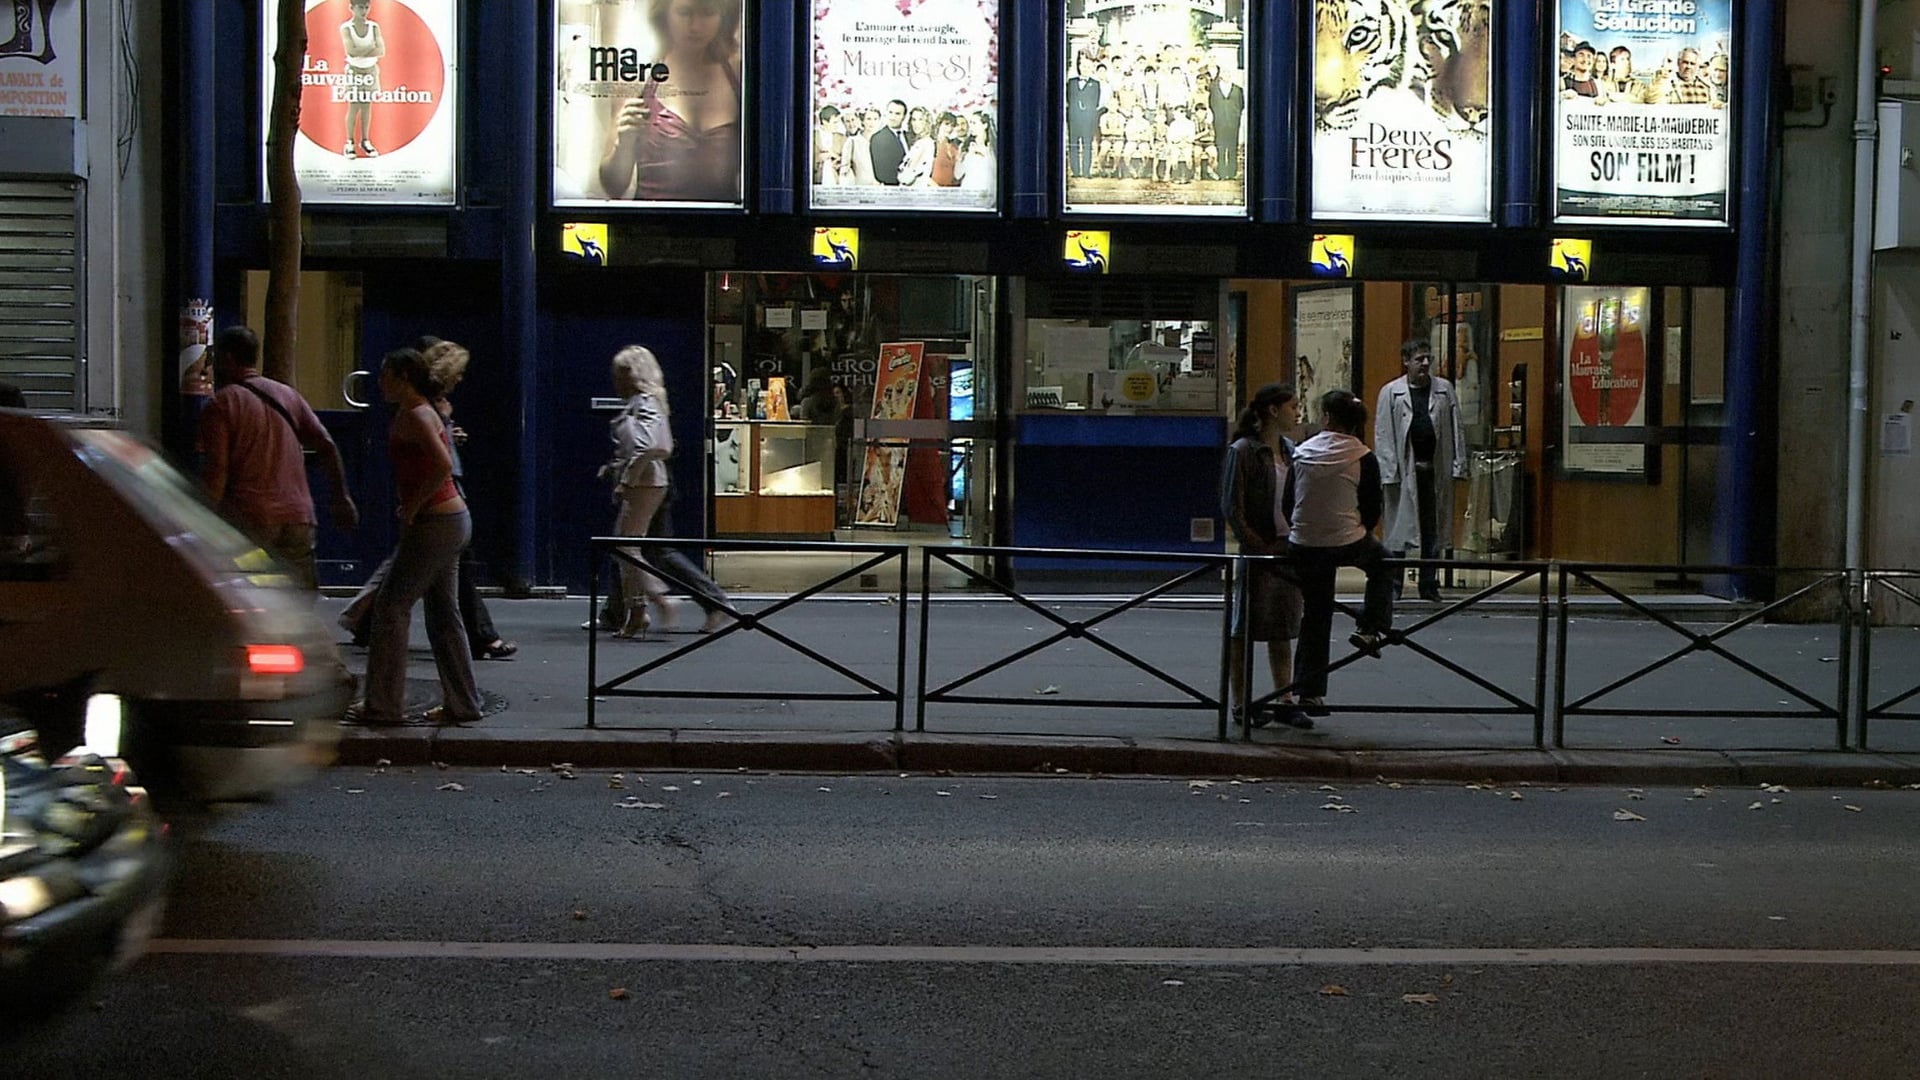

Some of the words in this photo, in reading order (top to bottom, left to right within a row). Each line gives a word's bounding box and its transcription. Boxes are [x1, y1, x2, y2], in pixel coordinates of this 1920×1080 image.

[900, 24, 915, 33] est
[842, 33, 852, 43] le
[898, 34, 910, 44] lui
[938, 36, 948, 45] la
[303, 55, 329, 72] La
[301, 69, 375, 86] auvaise
[331, 85, 433, 103] Education
[1368, 122, 1432, 147] Deux
[1591, 135, 1606, 147] SITE
[1641, 137, 1655, 149] SES
[1590, 151, 1629, 182] SON
[1637, 153, 1682, 183] FILM
[1690, 154, 1695, 184] !
[1579, 351, 1592, 365] La
[1592, 375, 1639, 389] Education
